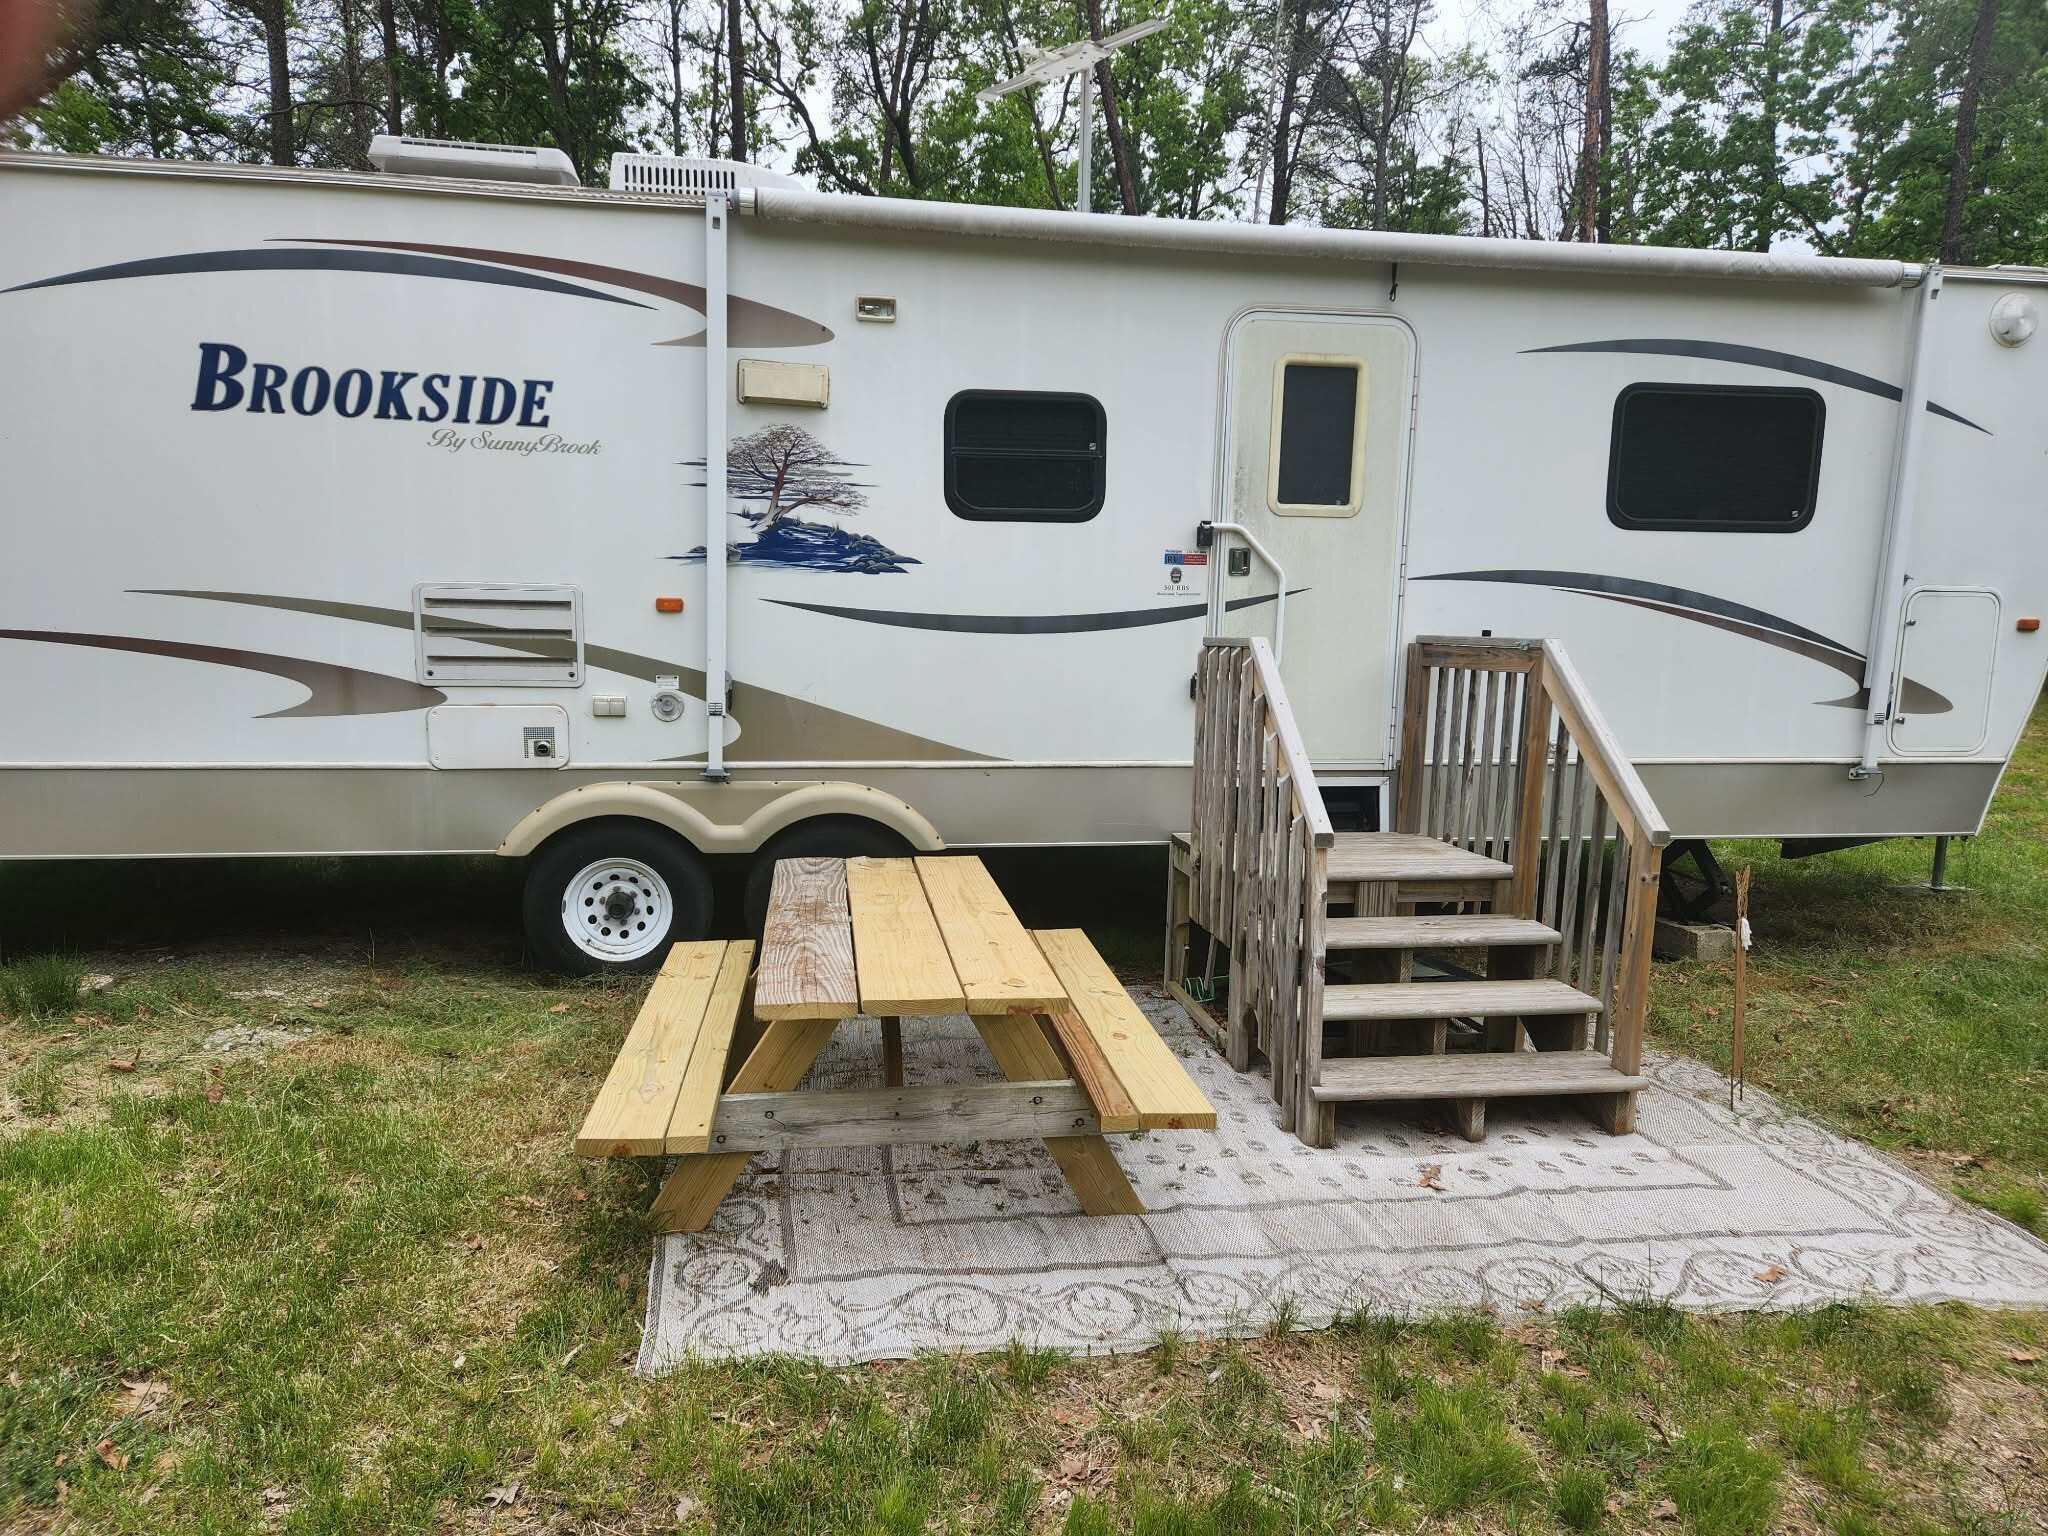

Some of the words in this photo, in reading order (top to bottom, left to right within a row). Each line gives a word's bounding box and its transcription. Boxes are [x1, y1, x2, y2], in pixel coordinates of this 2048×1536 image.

[191, 342, 555, 428] BROOKSIDE
[426, 429, 467, 453] By
[470, 430, 602, 457] SunnyBrook
